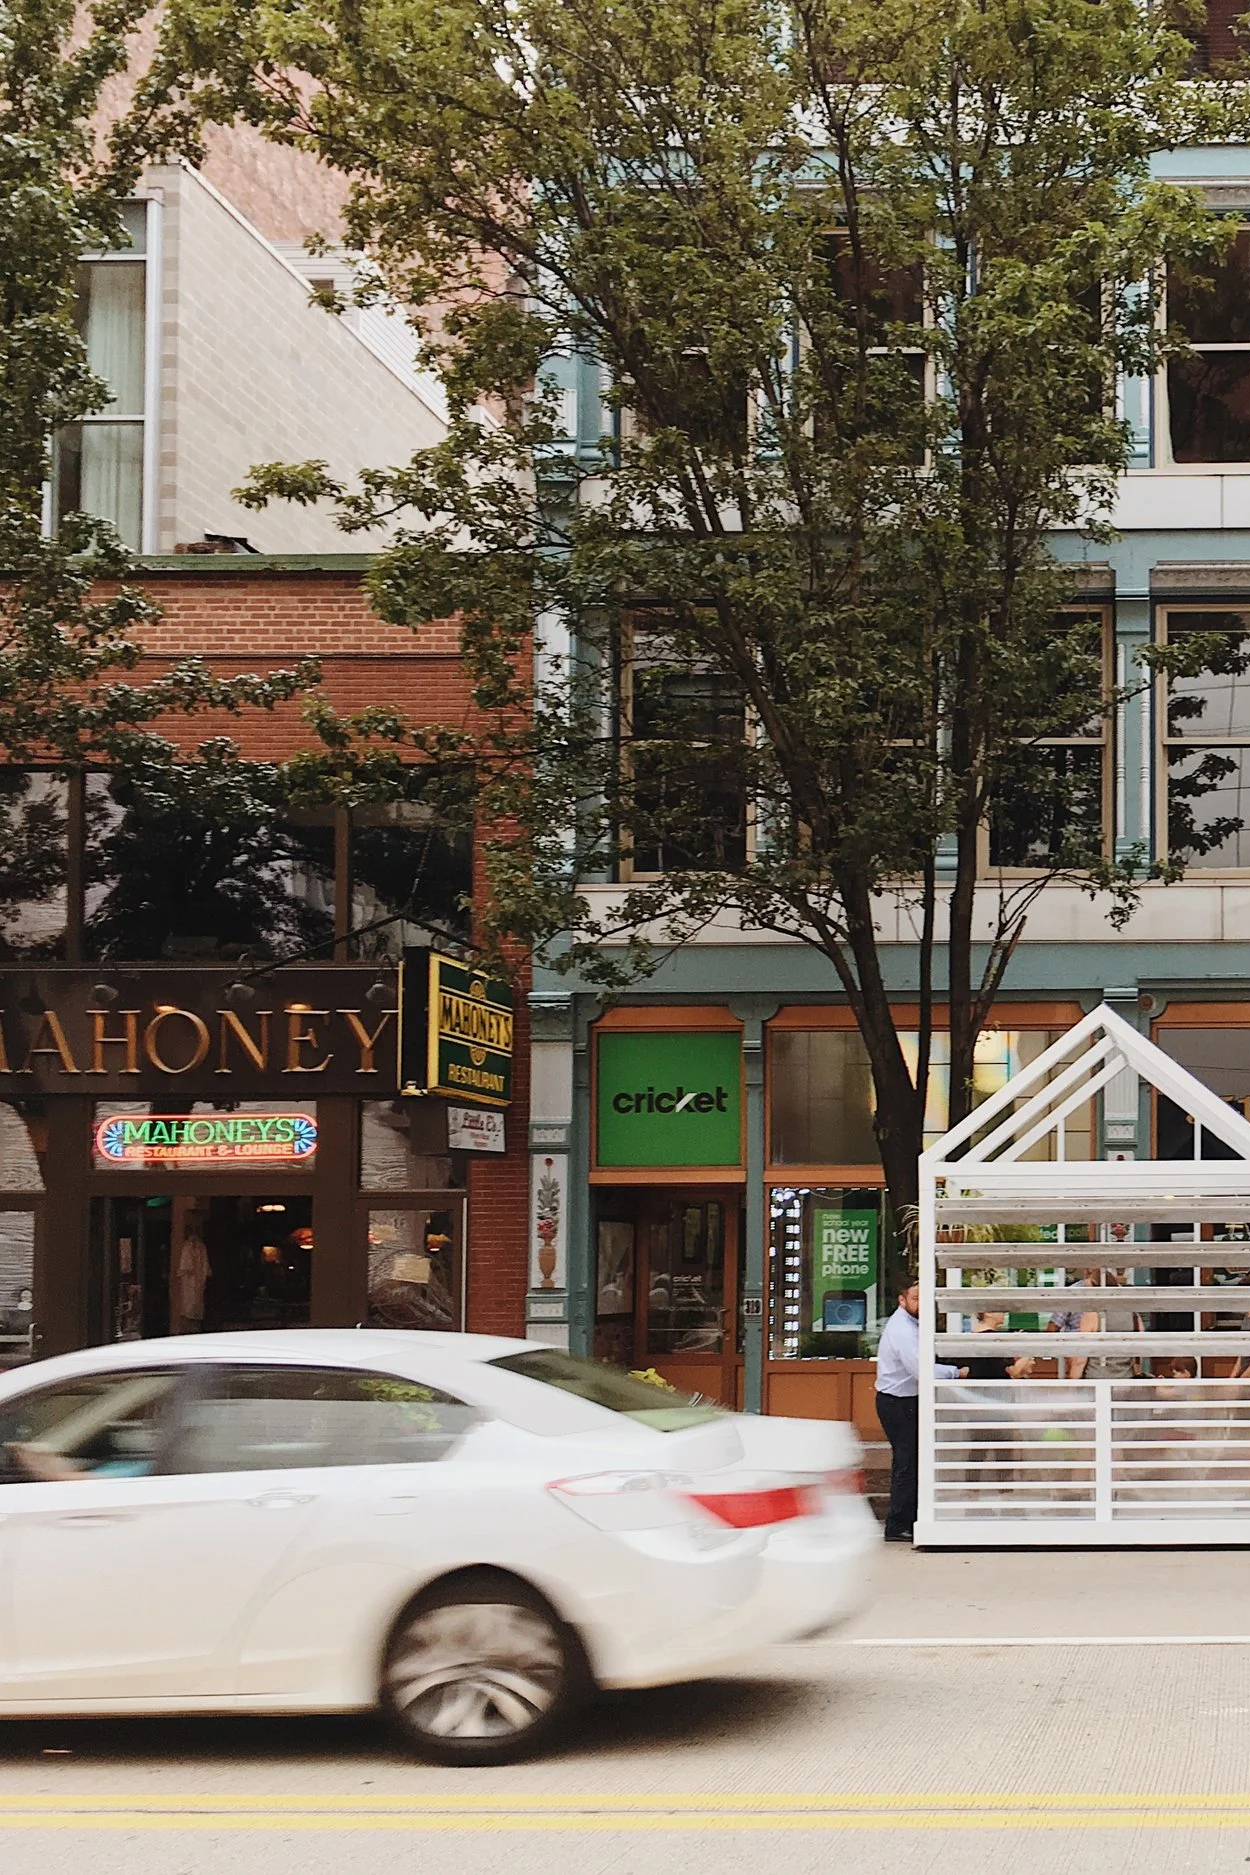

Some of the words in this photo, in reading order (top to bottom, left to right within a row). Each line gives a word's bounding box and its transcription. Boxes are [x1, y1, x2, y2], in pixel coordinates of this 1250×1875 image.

[0, 1009, 399, 1074] AHONEY
[448, 1063, 505, 1092] RESTAURANT
[612, 1086, 729, 1113] cricket
[122, 1117, 296, 1145] MAHONEY'S
[124, 1145, 213, 1158] RESTAURANT
[217, 1146, 230, 1156] &
[234, 1143, 294, 1155] LOUNGE
[822, 1228, 870, 1243] new
[822, 1244, 870, 1262] FREE
[822, 1262, 870, 1277] phone
